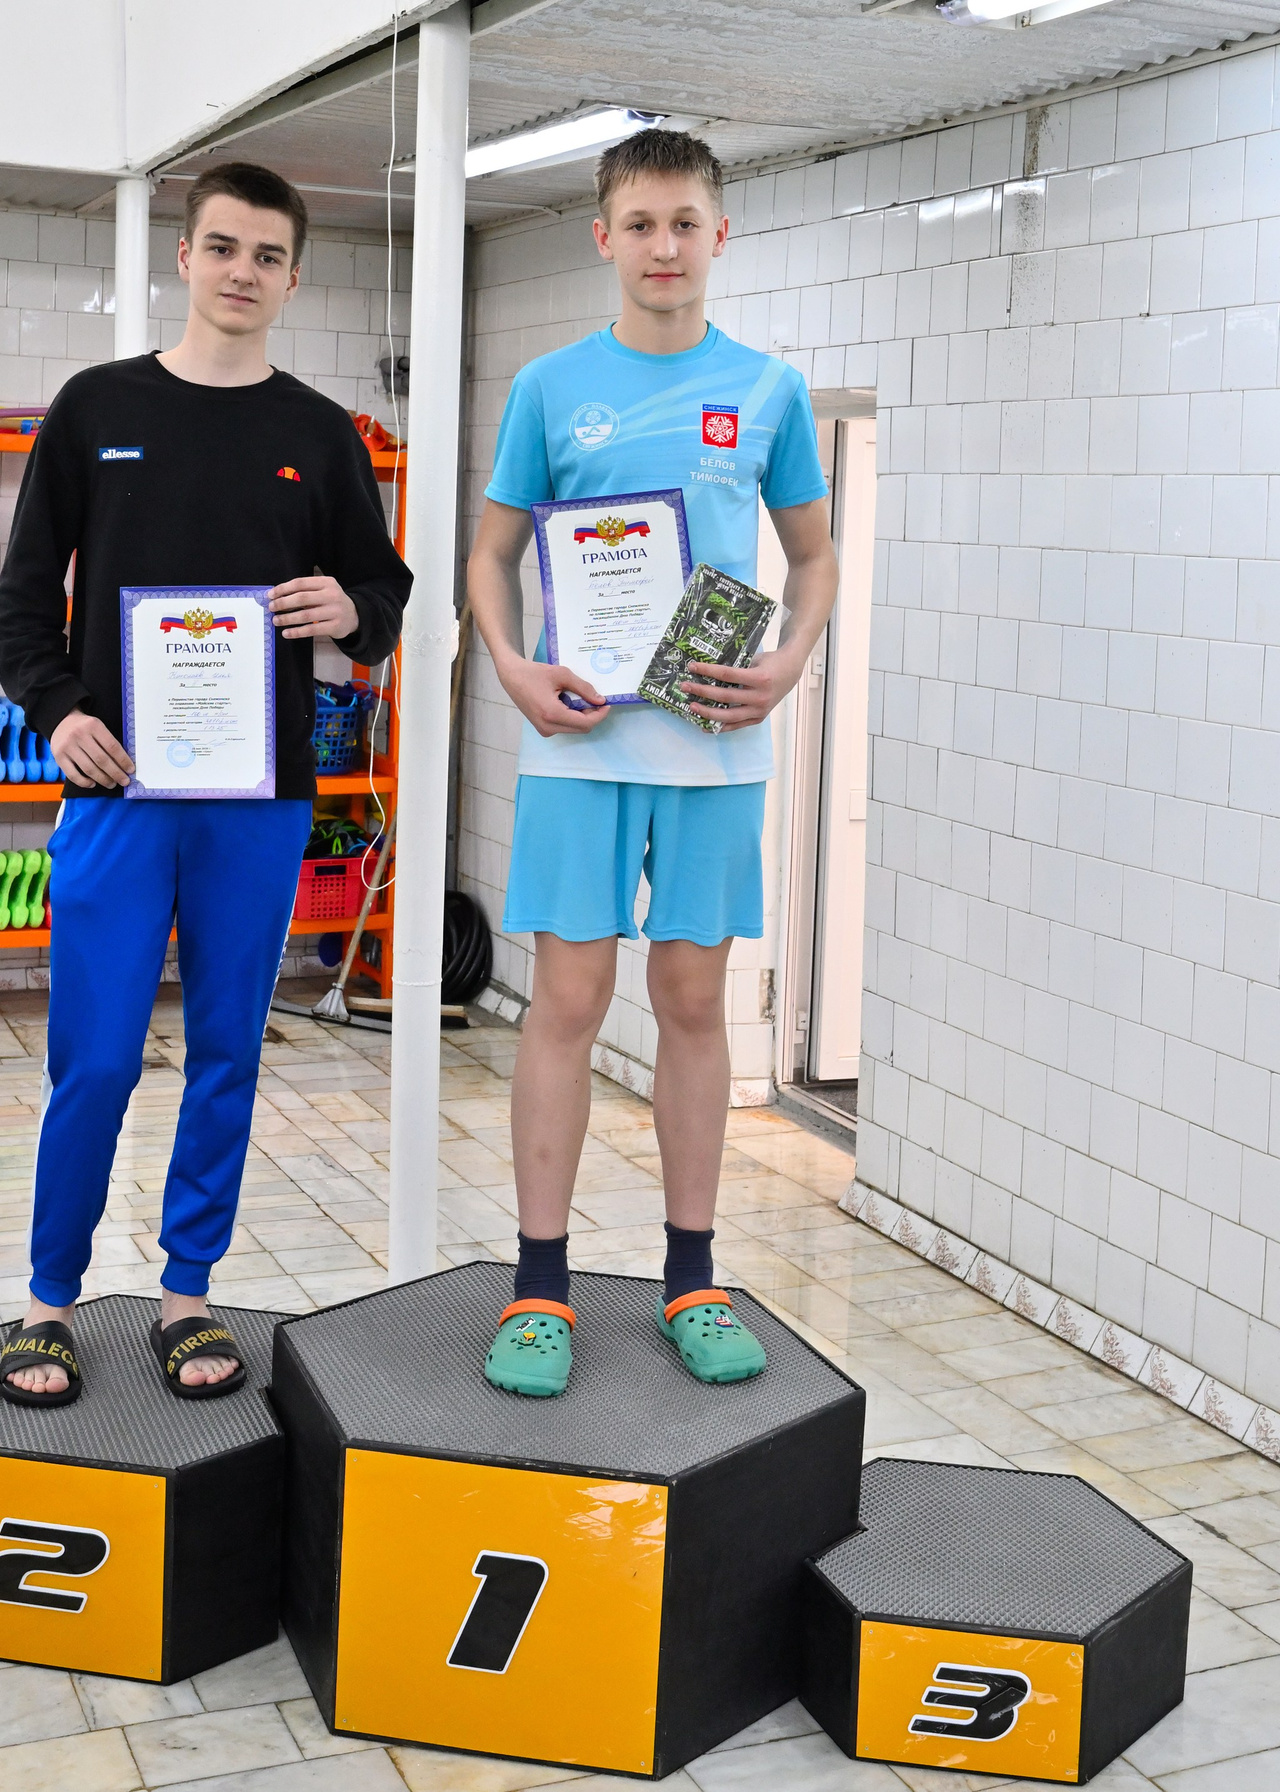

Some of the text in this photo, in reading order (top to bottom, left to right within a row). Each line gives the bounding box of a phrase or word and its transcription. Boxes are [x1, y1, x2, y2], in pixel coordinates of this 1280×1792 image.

[102, 449, 140, 460] ellesse
[700, 457, 736, 471] БЕЛОВ
[582, 548, 648, 564] ГРАМОТА
[589, 567, 642, 578] НАГРАЖДАЕТСЯ
[166, 643, 232, 654] ГРАМОТА
[445, 1550, 549, 1675] 1
[907, 1662, 1029, 1743] 3
